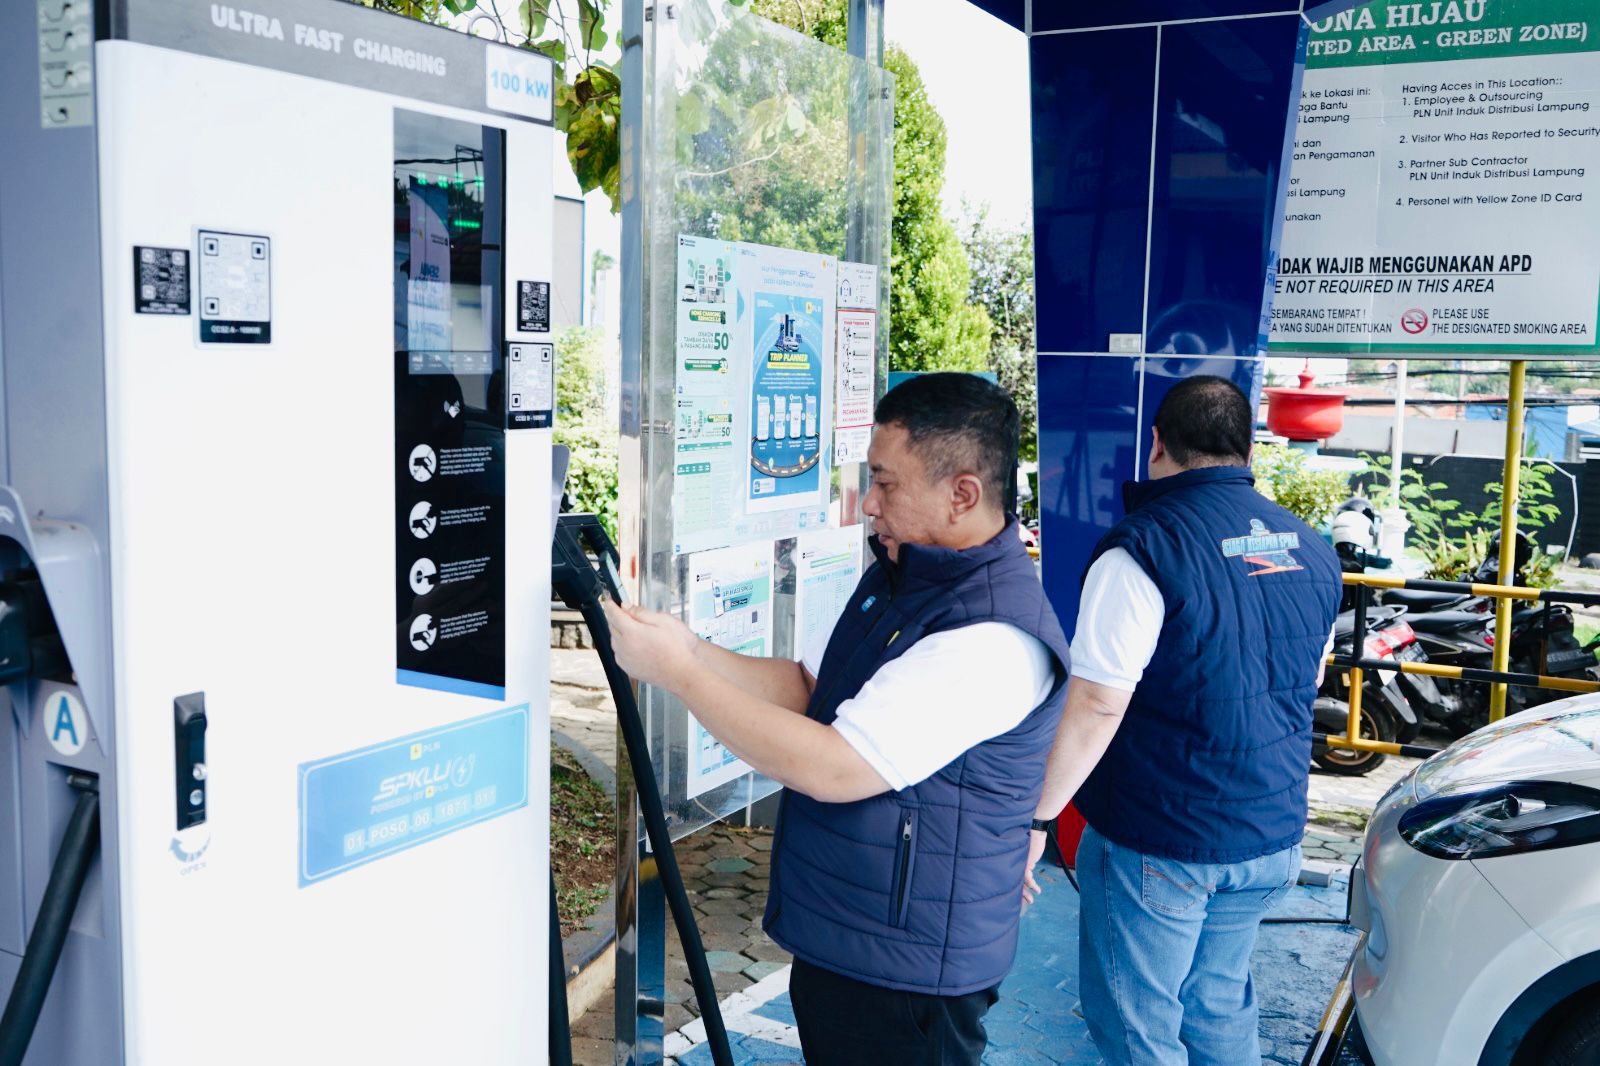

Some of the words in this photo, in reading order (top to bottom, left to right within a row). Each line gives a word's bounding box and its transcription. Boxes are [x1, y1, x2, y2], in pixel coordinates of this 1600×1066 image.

[1386, 0, 1487, 27] HIJAU
[211, 4, 284, 42] ULTRA
[293, 23, 344, 54] FAST
[352, 36, 446, 77] CHARGING
[1358, 34, 1416, 53] AREA
[1436, 27, 1512, 48] GREEN
[1519, 22, 1588, 43] ZONE)
[490, 69, 521, 95] 100
[524, 76, 549, 100] kW
[1402, 84, 1437, 94] Having
[1440, 83, 1472, 91] Acces
[1488, 80, 1506, 89] This
[1325, 88, 1353, 97] Lokasi
[1402, 98, 1410, 106] 1.
[1414, 94, 1465, 106] Employee
[1469, 94, 1475, 102] &
[1479, 91, 1543, 102] Outsourcing
[1320, 101, 1347, 110] Bantu
[1413, 109, 1431, 118] PLN
[1434, 108, 1453, 117] Unit
[1456, 106, 1485, 116] Induk
[1488, 103, 1534, 114] Distribusi
[1537, 102, 1590, 113] Lampung
[1304, 114, 1350, 124] Lampung
[1400, 135, 1408, 144] 2.
[1412, 134, 1440, 143] Visitor
[1444, 133, 1466, 142] Who
[1470, 132, 1489, 141] Has
[1492, 129, 1541, 141] Reported
[1545, 128, 1555, 137] to
[1558, 127, 1600, 137] Security
[1309, 150, 1374, 161] Pengamanan
[1398, 160, 1406, 169] 3.
[1410, 159, 1446, 168] Partner
[1449, 158, 1468, 167] Sub
[1471, 156, 1528, 166] Contractor
[1410, 172, 1427, 180] PLN
[1431, 171, 1449, 180] Unit
[1453, 171, 1481, 179] Induk
[1484, 169, 1530, 179] Distribusi
[1534, 168, 1585, 178] Lampung
[1300, 189, 1345, 197] Lampung
[1396, 198, 1404, 206] 4.
[1408, 197, 1450, 206] Personel
[1453, 196, 1473, 205] with
[1476, 195, 1507, 204] Yellow
[1511, 194, 1537, 203] Zone
[1541, 194, 1552, 202] ID
[1555, 193, 1582, 202] Card
[1317, 257, 1364, 274] WAJIB
[1369, 256, 1494, 273] MENGGUNAKAN
[1499, 255, 1532, 272] APD
[1286, 280, 1316, 293] NOT
[1319, 279, 1393, 293] REQUIRED
[1397, 280, 1412, 293] IN
[1417, 279, 1450, 292] THIS
[1452, 279, 1494, 292] AREA
[1328, 309, 1360, 319] TEMPAT
[1433, 308, 1468, 319] PLEASE
[1471, 309, 1489, 318] USE
[1280, 323, 1302, 333] YANG
[1305, 323, 1333, 333] SUDAH
[1337, 323, 1392, 333] DITENTUKAN
[1432, 324, 1449, 334] THE
[1452, 324, 1510, 334] DESIGNATED
[1513, 324, 1557, 334] SMOKING
[1560, 324, 1587, 334] AREA
[714, 332, 729, 350] 50
[53, 696, 79, 746] A
[371, 759, 452, 802] SPKLU
